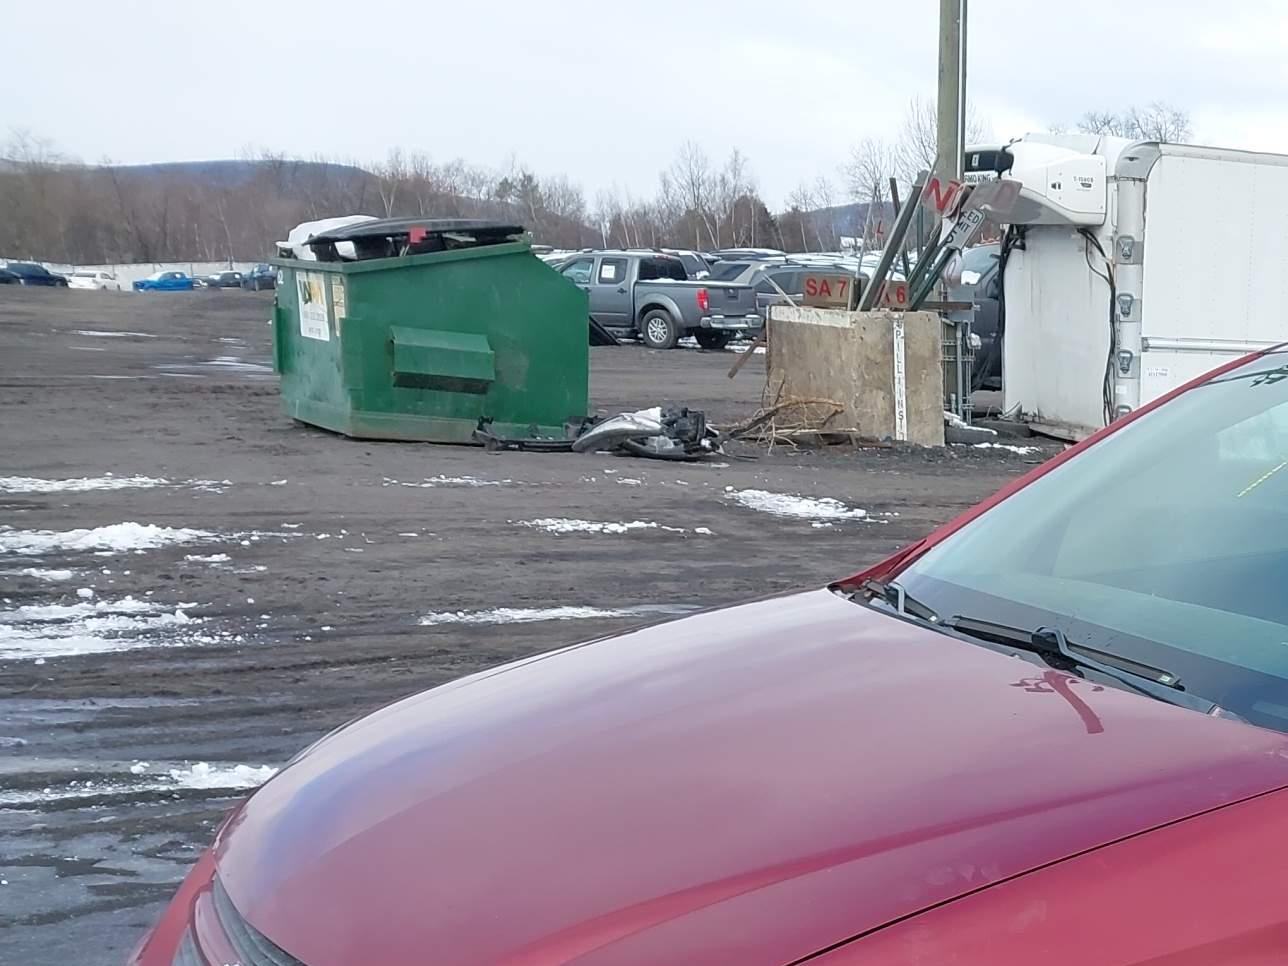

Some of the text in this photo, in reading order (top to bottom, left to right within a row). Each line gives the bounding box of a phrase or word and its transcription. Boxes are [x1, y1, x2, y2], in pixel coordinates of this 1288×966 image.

[806, 278, 847, 297] SA 7
[896, 286, 906, 304] 6
